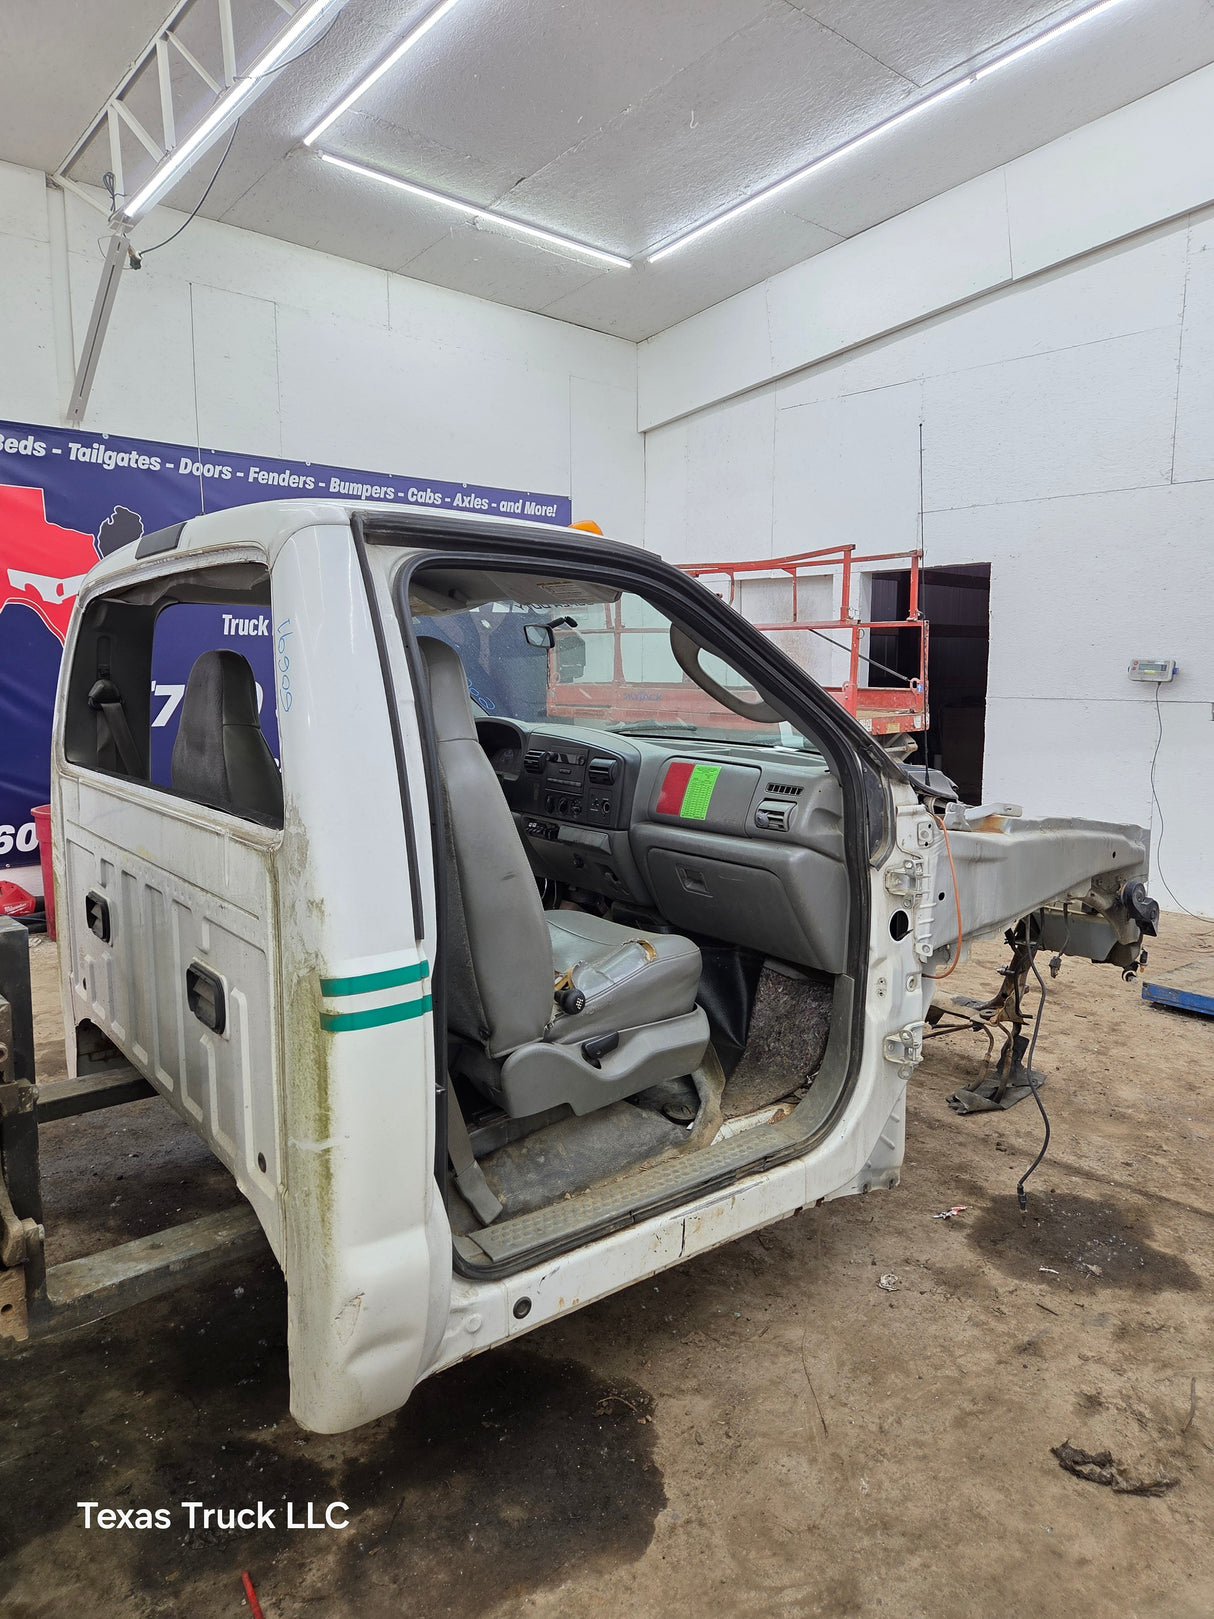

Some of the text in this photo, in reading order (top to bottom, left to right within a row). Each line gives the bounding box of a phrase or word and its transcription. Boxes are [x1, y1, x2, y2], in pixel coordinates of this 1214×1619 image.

[68, 442, 161, 471] Tailgates
[178, 457, 232, 480] Doors
[248, 466, 315, 489] Fenders
[329, 477, 395, 500] Bumpers
[407, 487, 442, 505] Cabs
[453, 492, 489, 510] Axles
[499, 499, 522, 514] and
[524, 501, 557, 518] More!
[222, 614, 270, 636] Truck
